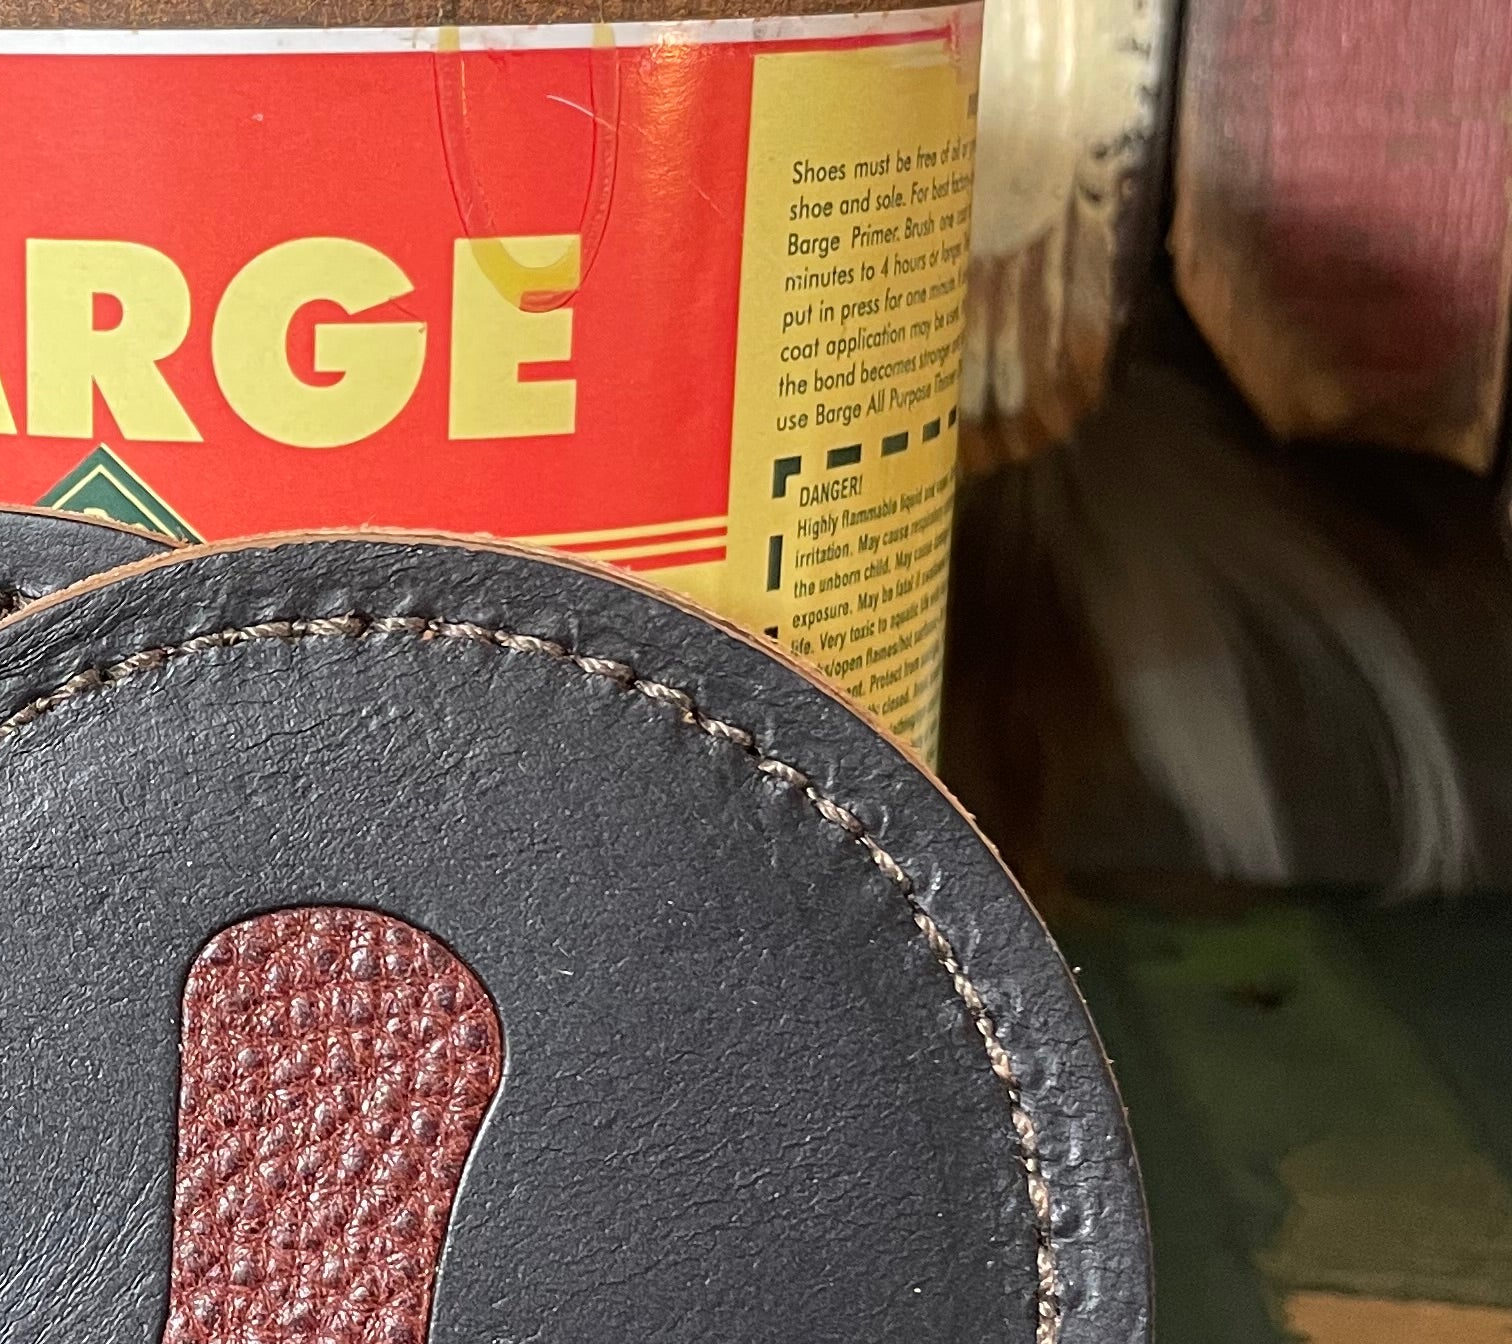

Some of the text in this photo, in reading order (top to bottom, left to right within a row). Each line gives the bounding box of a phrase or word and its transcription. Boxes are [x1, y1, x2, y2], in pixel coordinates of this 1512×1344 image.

[792, 160, 846, 185] Shoes
[854, 153, 890, 179] must
[896, 148, 911, 173] be
[916, 144, 937, 170] free
[789, 196, 833, 221] shoe
[839, 188, 871, 216] and
[875, 184, 906, 211] sole.
[911, 181, 929, 205] For
[788, 233, 840, 258] Barge
[851, 224, 900, 249] Primer.
[904, 211, 935, 240] Brush
[784, 264, 854, 292] minutes
[861, 261, 875, 282] to
[880, 256, 889, 278] 4
[894, 252, 927, 277] hours
[929, 251, 939, 268] or
[782, 301, 813, 334] put
[819, 296, 835, 324] in
[840, 297, 880, 329] press
[884, 287, 903, 312] for
[906, 287, 927, 307] one
[780, 336, 820, 363] coat
[826, 321, 906, 360] application
[910, 320, 931, 341] may
[778, 370, 808, 399] the
[814, 361, 856, 393] bond
[860, 355, 916, 384] becomes
[776, 407, 809, 432] use
[815, 401, 862, 428] Barge
[866, 388, 886, 417] All
[889, 382, 931, 413] Purpose
[799, 474, 863, 507] DANGER!
[797, 513, 839, 541] Highly
[842, 498, 898, 529] flammable
[794, 541, 853, 569] irritation.
[857, 533, 881, 554] May
[882, 524, 909, 546] cause
[794, 580, 816, 599] the
[819, 569, 861, 594] unborn
[864, 556, 891, 581] child.
[895, 551, 913, 570] May
[792, 601, 853, 630] exposure.
[857, 592, 879, 613] May
[882, 585, 893, 603] be
[820, 632, 847, 651] Very
[850, 619, 874, 643] toxic
[878, 616, 887, 633] to
